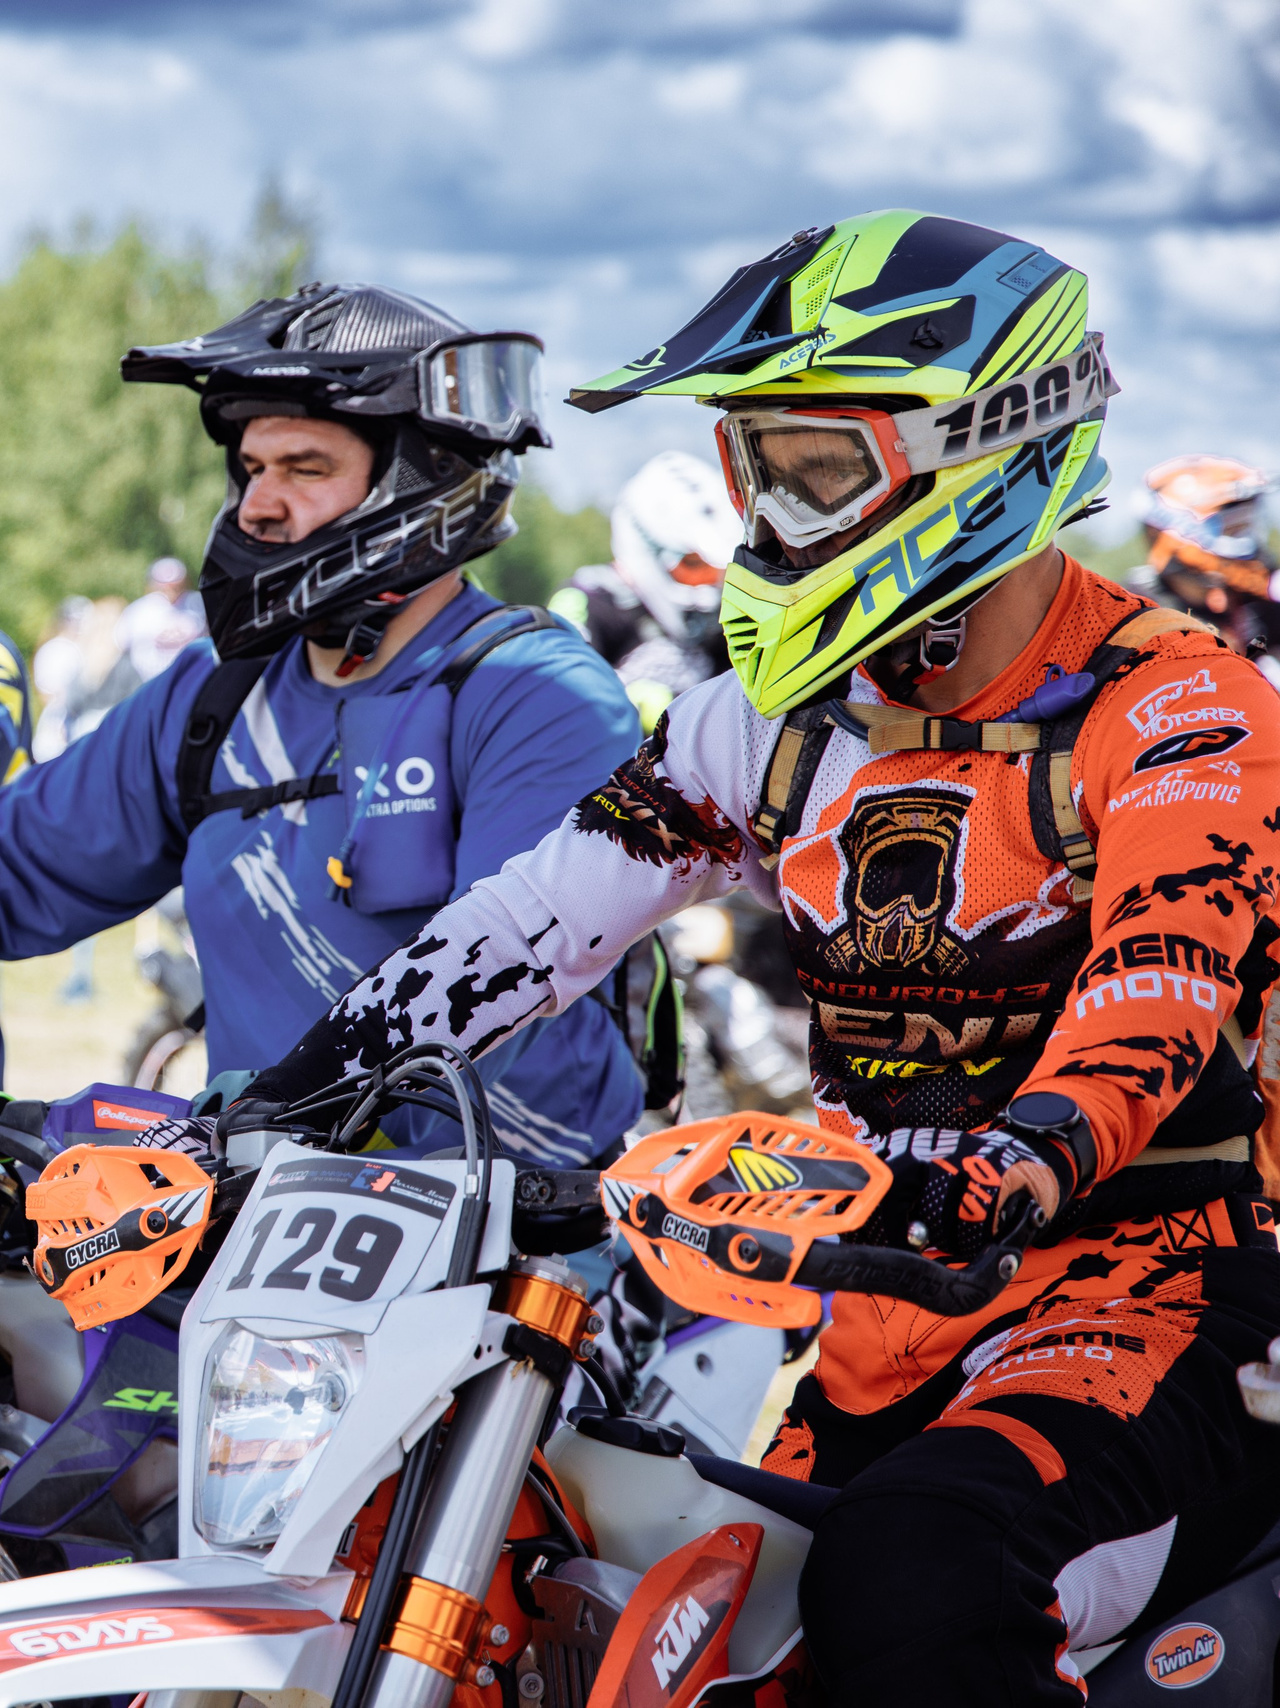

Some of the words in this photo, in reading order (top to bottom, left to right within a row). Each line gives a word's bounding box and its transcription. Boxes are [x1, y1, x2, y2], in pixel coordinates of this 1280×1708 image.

[779, 333, 837, 370] ACERBIS
[391, 797, 437, 815] OPTIONS
[1078, 933, 1236, 994] REME
[1076, 971, 1217, 1020] MOTO
[65, 1228, 121, 1270] CYCRA
[661, 1213, 710, 1252] CYCRA
[226, 1207, 404, 1302] 129
[988, 1346, 1113, 1376] MOTO
[10, 1615, 174, 1657] 6DAYS
[651, 1595, 710, 1690] KTM
[1153, 1646, 1194, 1678] Twin
[1193, 1634, 1216, 1660] Air
